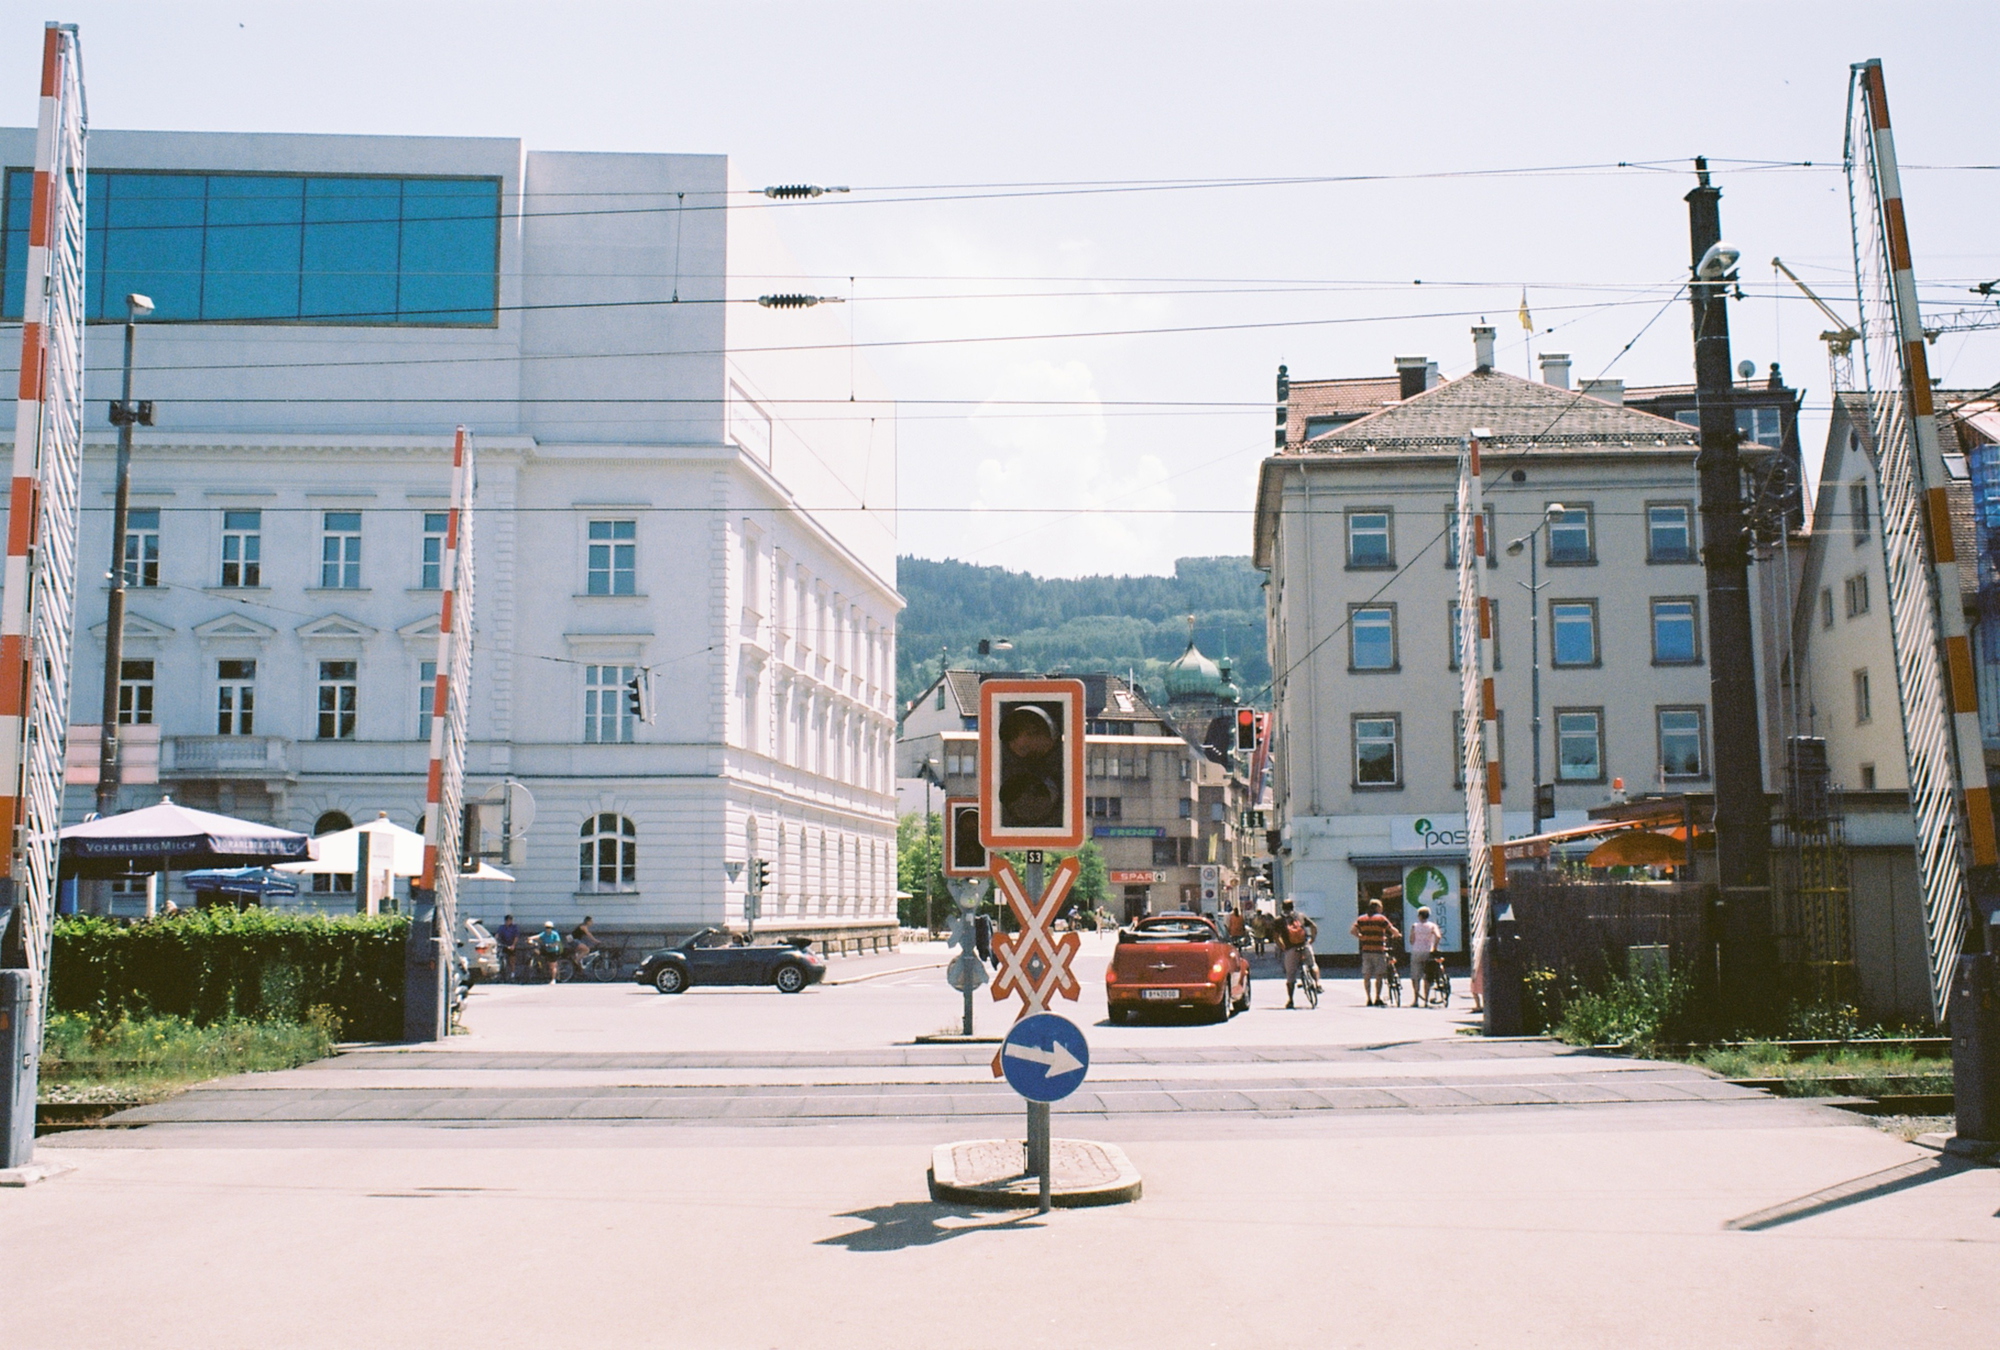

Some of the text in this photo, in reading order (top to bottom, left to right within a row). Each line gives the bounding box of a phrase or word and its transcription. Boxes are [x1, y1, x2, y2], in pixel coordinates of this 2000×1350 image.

[1425, 831, 1467, 849] pas
[1029, 851, 1041, 863] S3
[1120, 873, 1153, 881] SPAR
